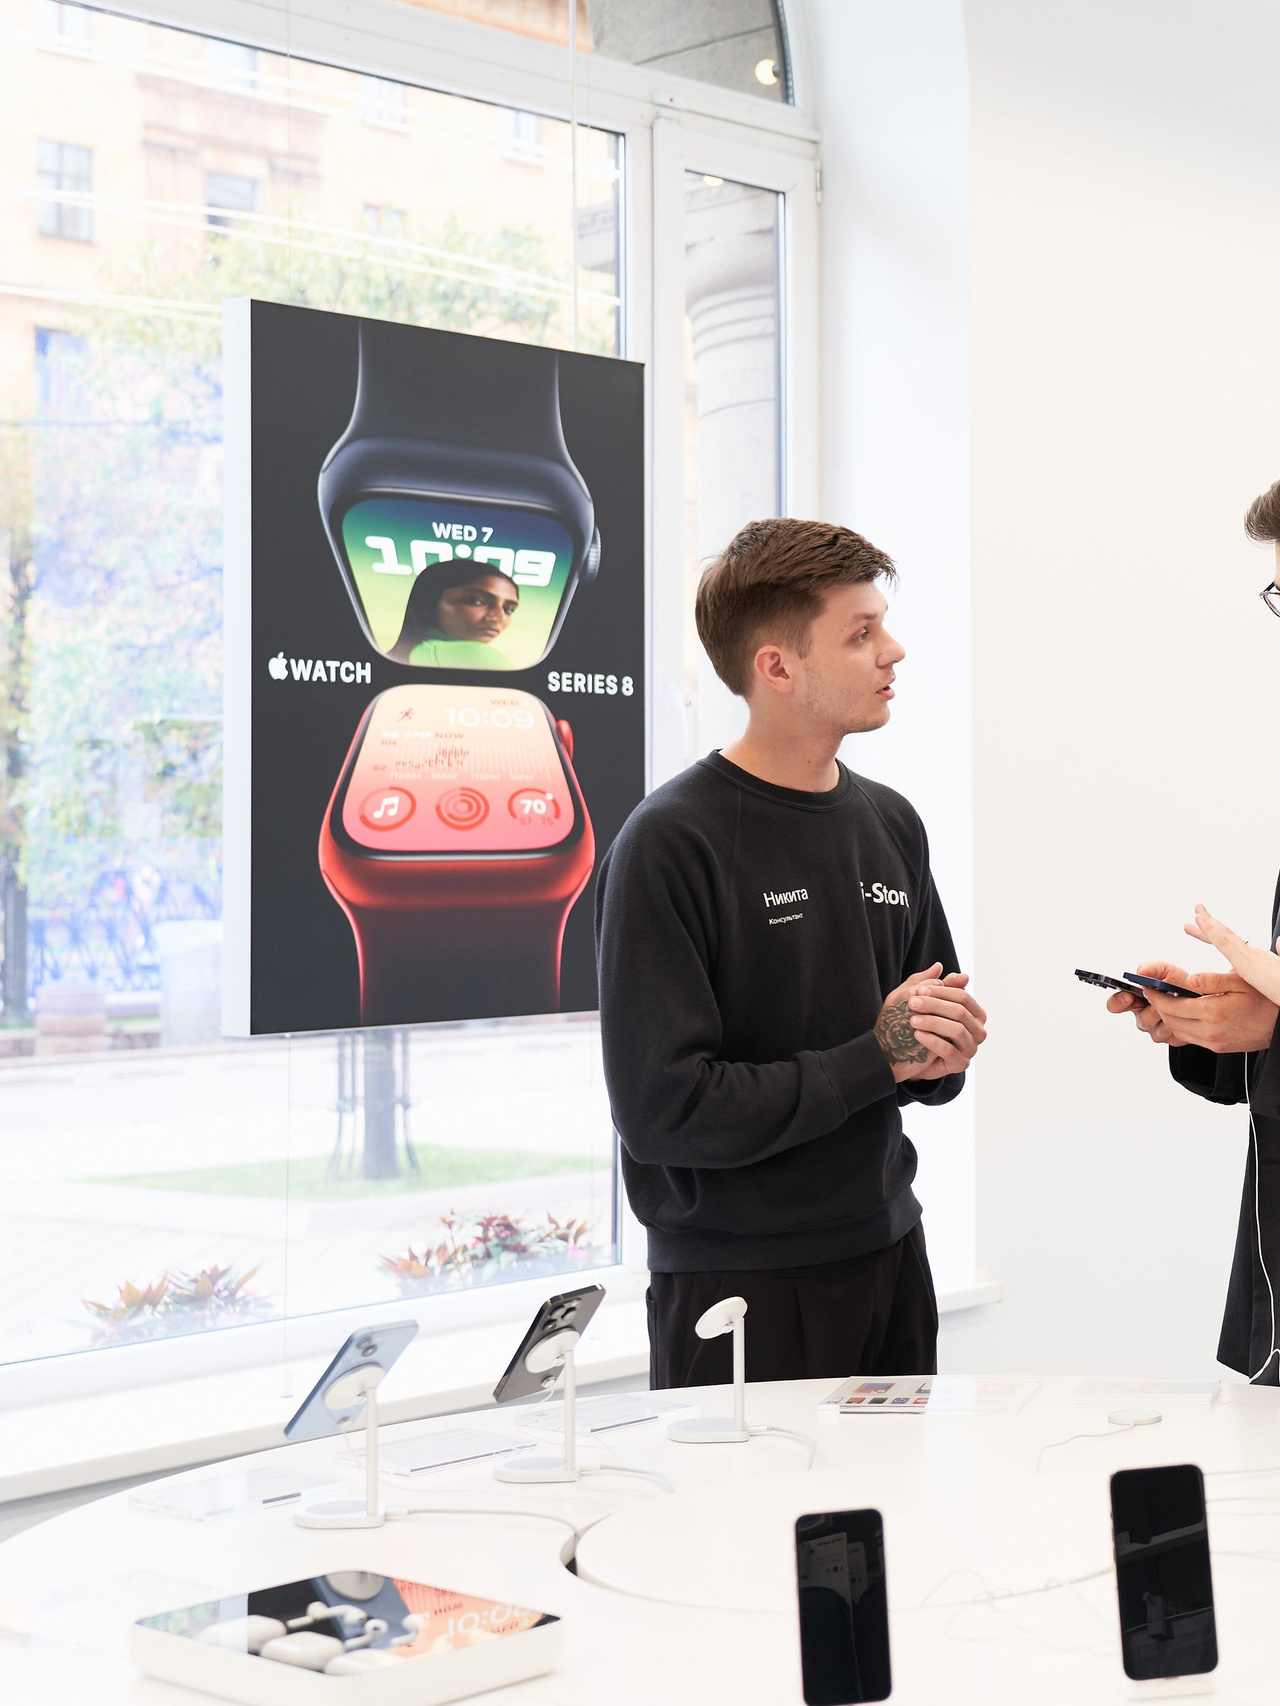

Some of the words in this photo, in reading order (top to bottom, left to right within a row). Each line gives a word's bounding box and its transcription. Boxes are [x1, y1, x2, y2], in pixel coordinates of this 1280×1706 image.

[432, 521, 477, 542] WED
[481, 526, 494, 543] 7
[289, 658, 372, 684] WATCH
[547, 670, 618, 696] SERIES
[621, 675, 635, 697] 8
[489, 699, 519, 707] WED
[442, 706, 535, 729] 10:09
[520, 798, 547, 815] 70
[763, 888, 809, 908] Никита
[768, 913, 804, 925] Консультант
